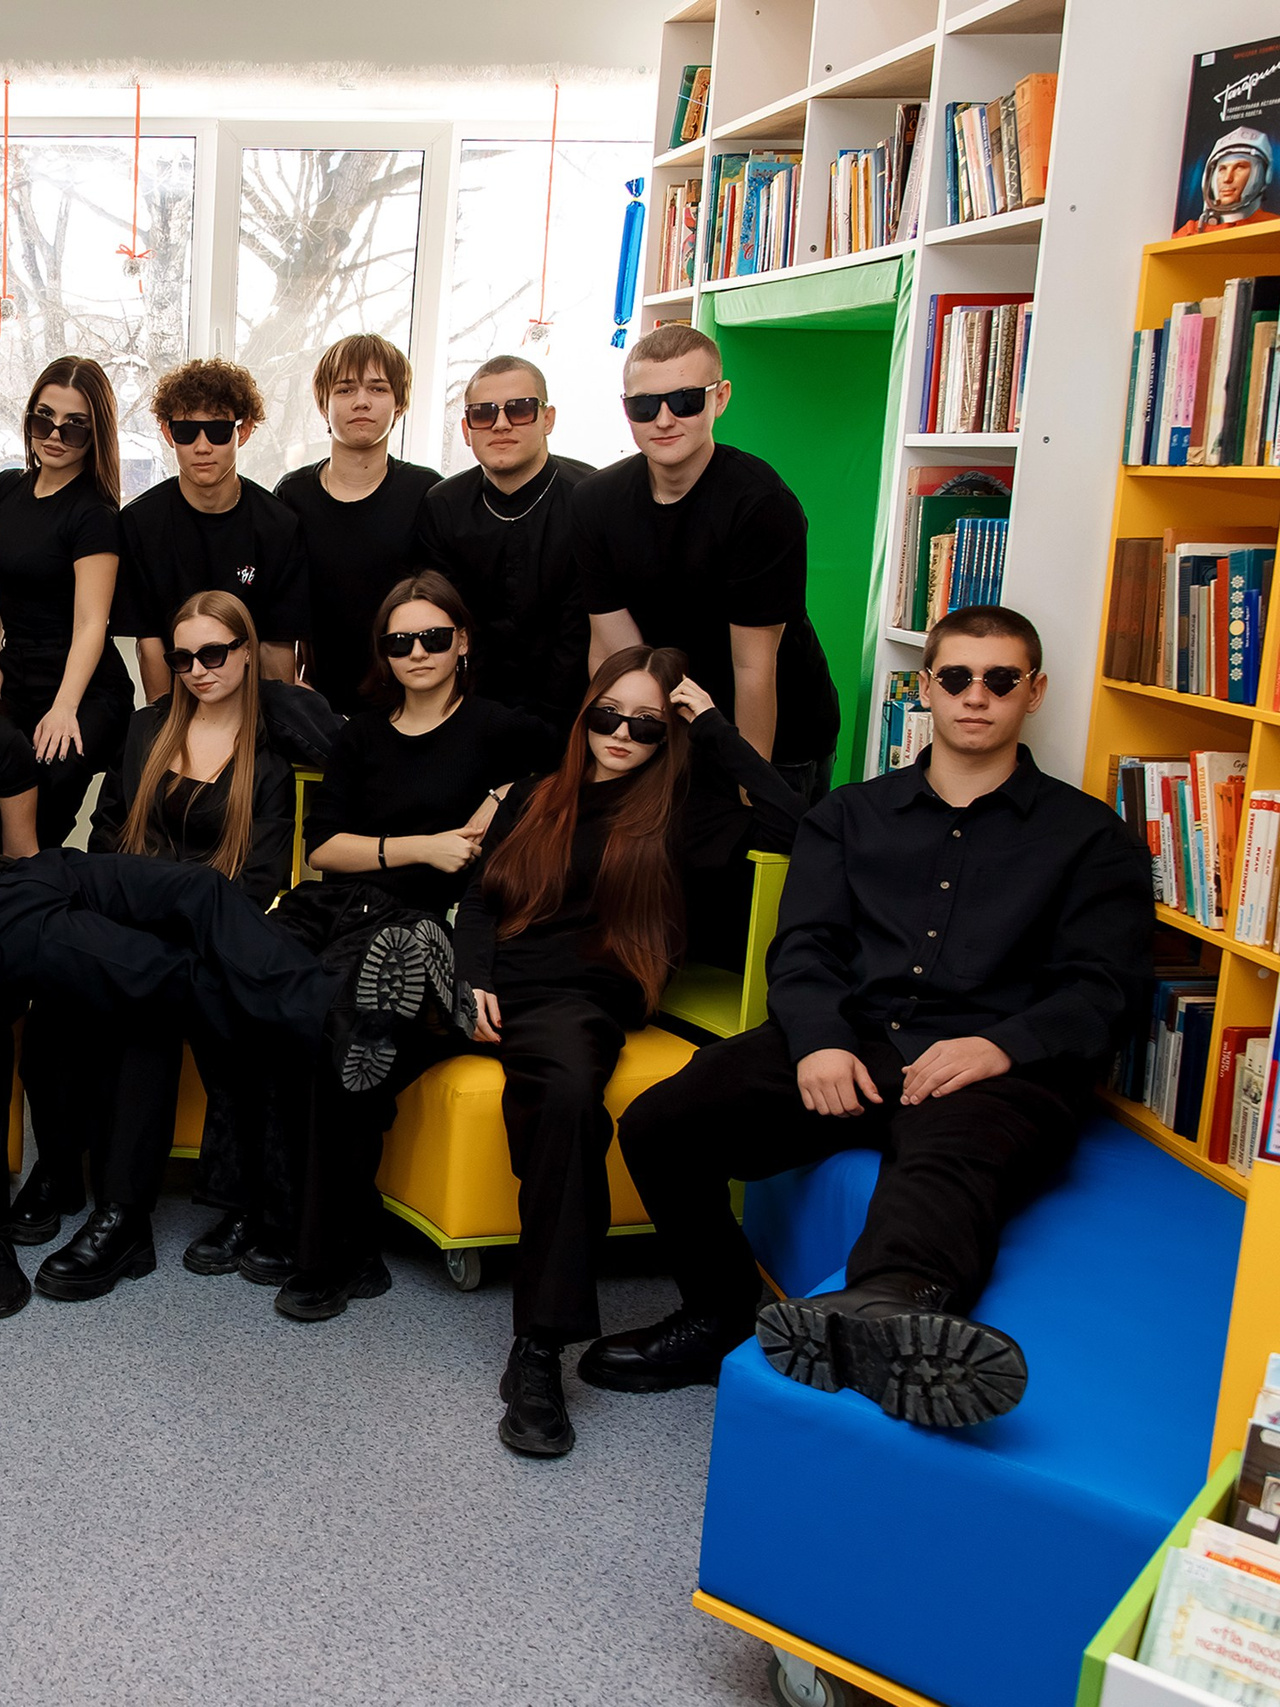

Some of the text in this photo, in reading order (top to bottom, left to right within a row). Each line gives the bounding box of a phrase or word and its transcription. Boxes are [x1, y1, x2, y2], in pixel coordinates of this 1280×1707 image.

[1197, 765, 1208, 811] БЕРЛИНА
[1200, 812, 1208, 825] ДО
[1201, 826, 1212, 867] МОСКВЫ
[1205, 870, 1211, 881] ОТ
